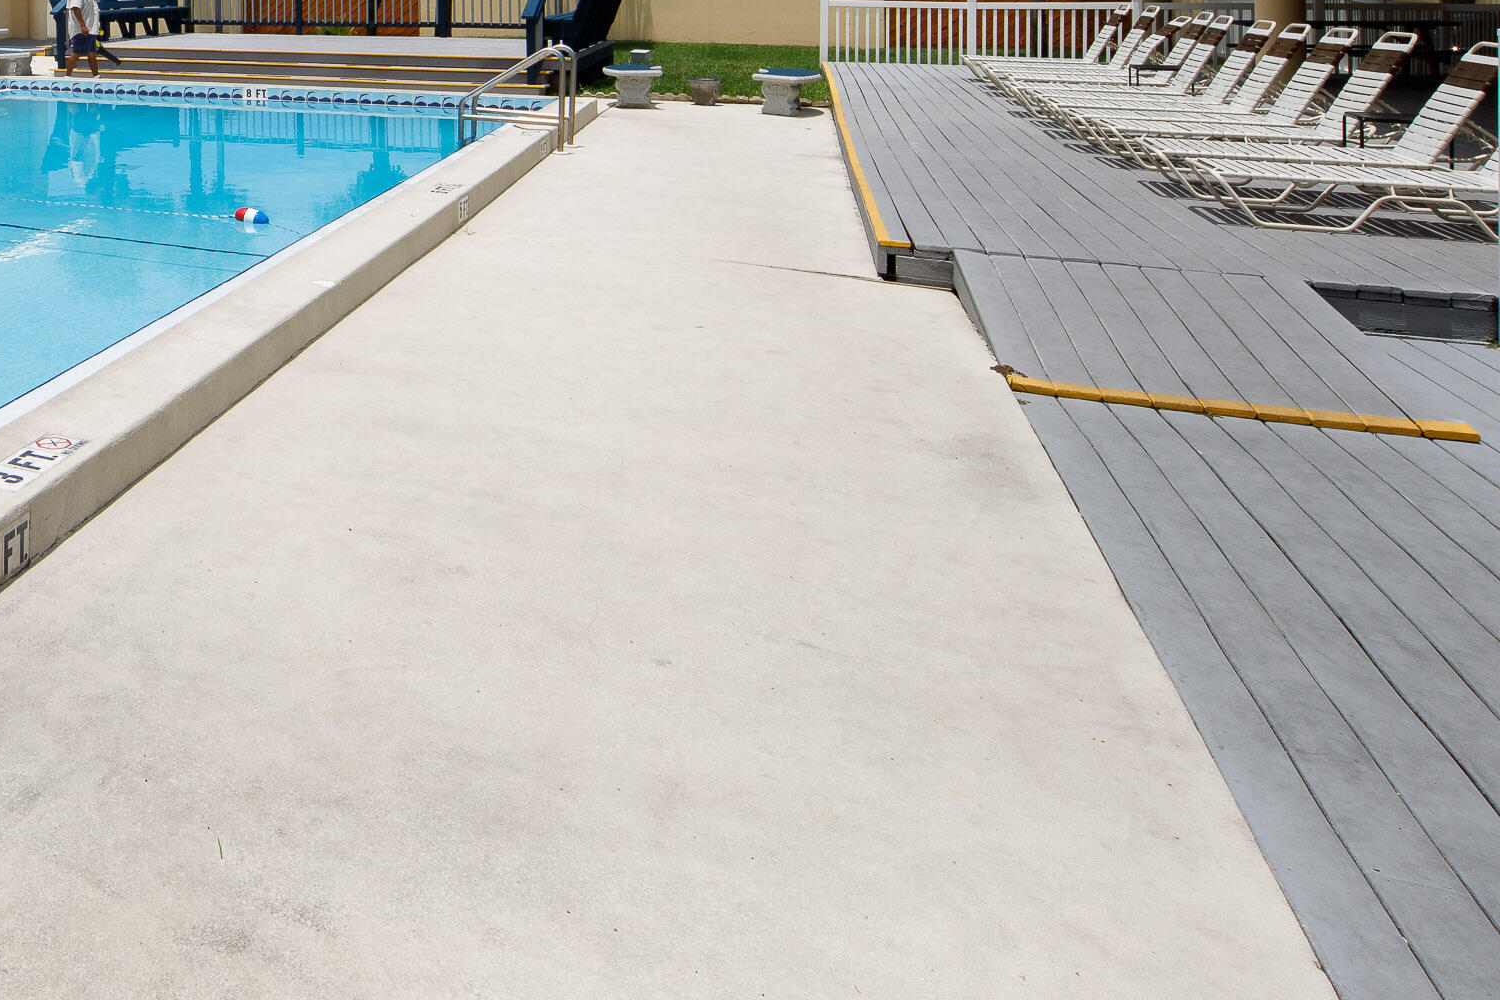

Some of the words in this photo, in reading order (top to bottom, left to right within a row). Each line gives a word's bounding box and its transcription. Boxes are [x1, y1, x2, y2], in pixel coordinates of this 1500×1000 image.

[247, 89, 252, 98] 8
[7, 450, 59, 471] FT.
[3, 519, 29, 577] FT.
